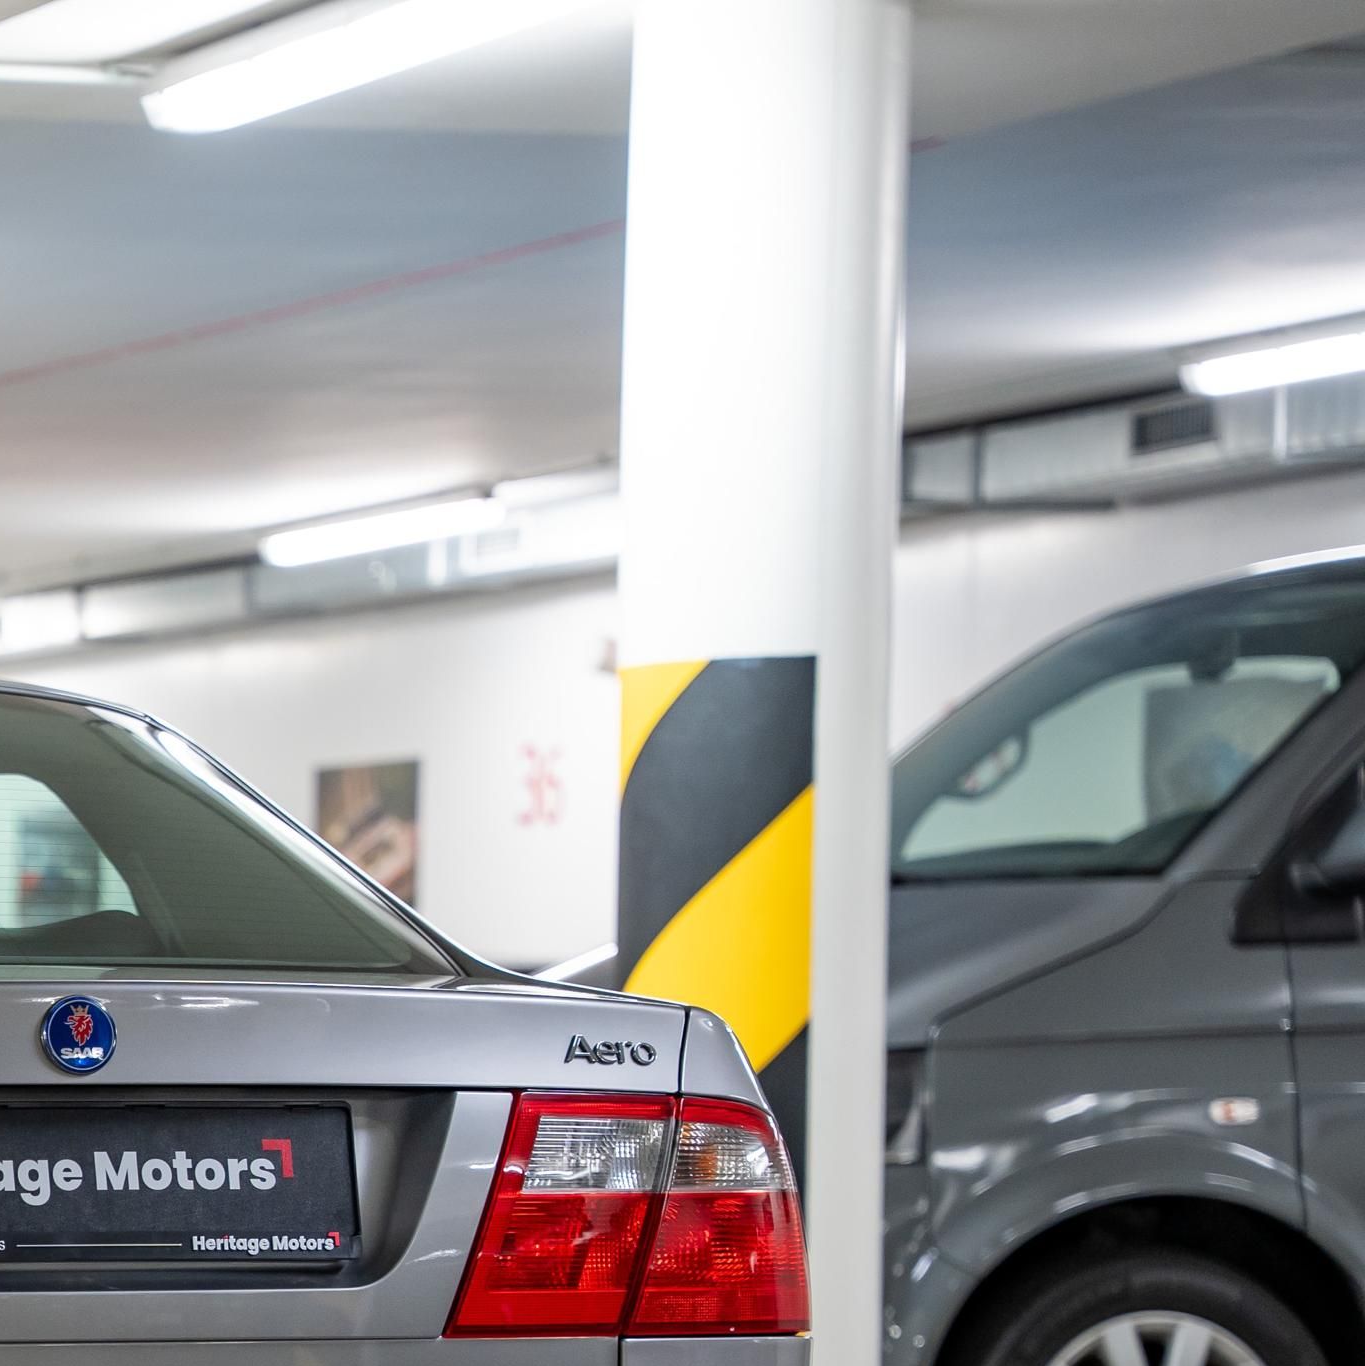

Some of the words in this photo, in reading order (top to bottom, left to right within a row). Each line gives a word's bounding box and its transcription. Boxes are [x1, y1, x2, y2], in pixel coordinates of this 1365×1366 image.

[60, 1047, 104, 1060] SAAB
[563, 1033, 657, 1066] Aero
[94, 1150, 277, 1191] Motors
[192, 1234, 270, 1256] Heritage
[272, 1235, 335, 1251] Motors
